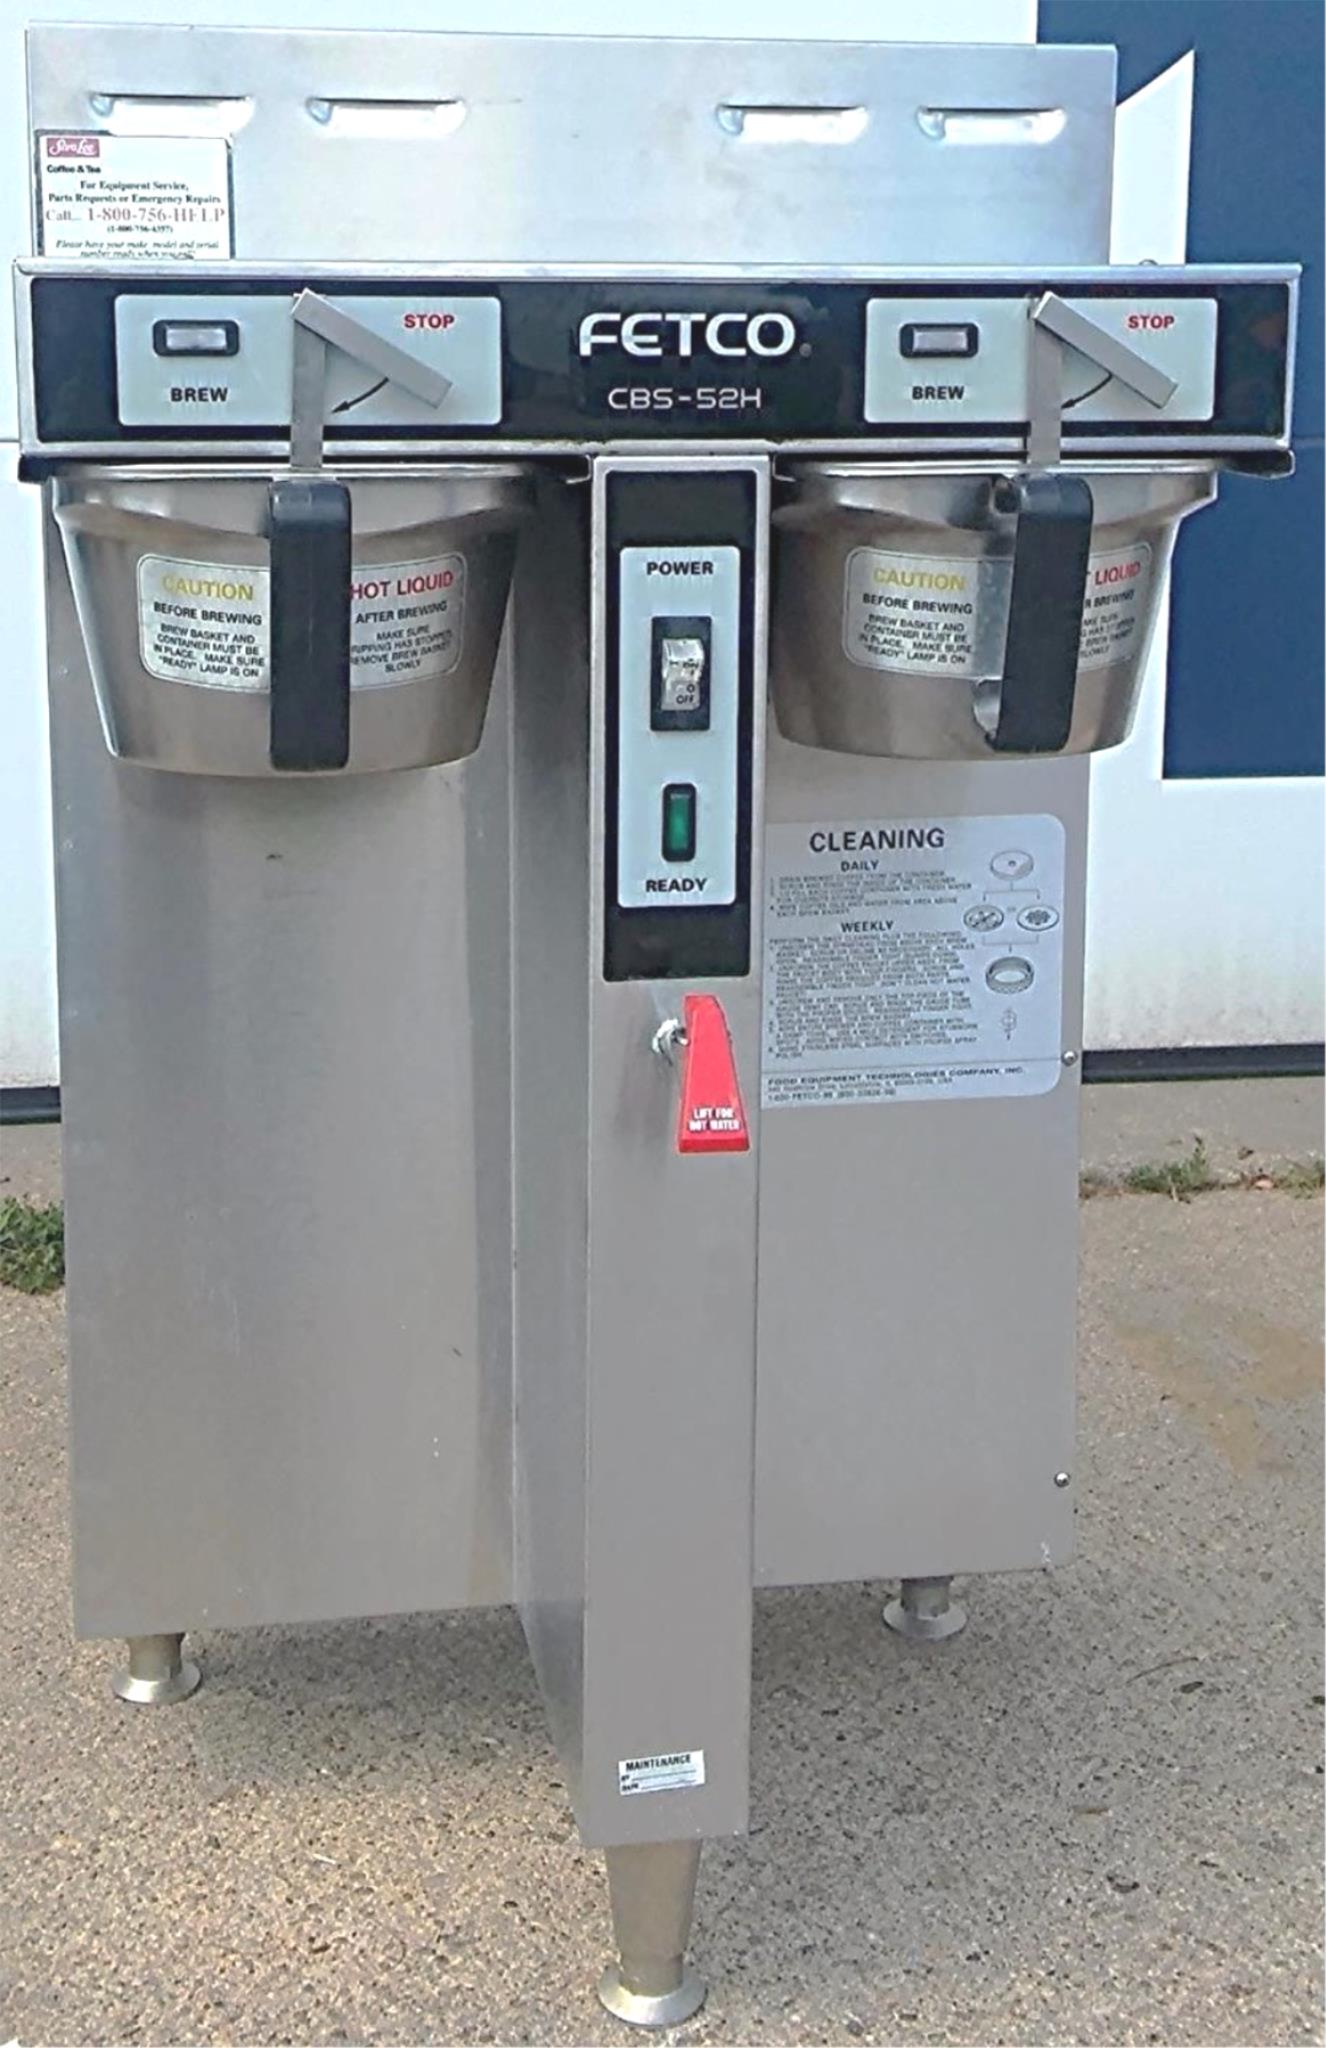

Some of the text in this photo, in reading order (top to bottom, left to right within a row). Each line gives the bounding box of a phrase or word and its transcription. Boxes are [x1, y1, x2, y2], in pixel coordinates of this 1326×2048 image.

[47, 165, 101, 173] Coffee & Tea
[80, 181, 189, 191] For Equipment Service,
[49, 193, 73, 202] Parts
[75, 193, 116, 204] Requests
[132, 193, 183, 204] Emergency
[186, 194, 221, 204] Repairs
[180, 241, 194, 249] and
[404, 314, 455, 329] STOP
[1127, 315, 1175, 329] STOP
[579, 313, 796, 357] FETCO
[171, 388, 228, 402] BREW
[608, 388, 762, 409] CBS-52H
[912, 386, 965, 400] BREW
[646, 561, 714, 575] POWER
[1094, 561, 1141, 586] LIQUID
[349, 570, 454, 600] HOT LIQUID
[873, 567, 966, 590] CAUTION
[162, 574, 254, 600] CAUTION
[863, 593, 973, 615] BEFORE BREWING
[154, 602, 262, 626] BEFORE BREWING
[355, 601, 448, 624] AFTER BREWING
[868, 613, 964, 631] BREW BASKET AND
[161, 623, 255, 644] BREW BASKET AND
[376, 625, 430, 640] MAKE SURE
[863, 623, 967, 643] CONTAINER MUST BE
[157, 633, 260, 656] CONTAINER MUST BE
[394, 639, 414, 649] HAS
[859, 634, 972, 653] IN PLACE. MAKE SURE
[153, 644, 265, 666] IN PLACE. MAKE SURE
[392, 648, 418, 660] BREW
[864, 645, 965, 664] "READY" LAMP IS ON
[159, 655, 259, 677] "READY" LAMP IS ON
[385, 659, 421, 672] SLOWLY
[809, 827, 945, 853] CLEANING
[840, 860, 880, 872] DAILY
[646, 878, 708, 892] READY
[840, 920, 895, 933] WEEKLY
[767, 1078, 798, 1086] FOOD
[801, 1074, 862, 1083] EQUIPMENT
[866, 1070, 946, 1081] TECHNOLOGIES
[693, 1107, 713, 1119] LIFT
[710, 1119, 740, 1131] WATER
[626, 1754, 691, 1771] MAINTENANCE
